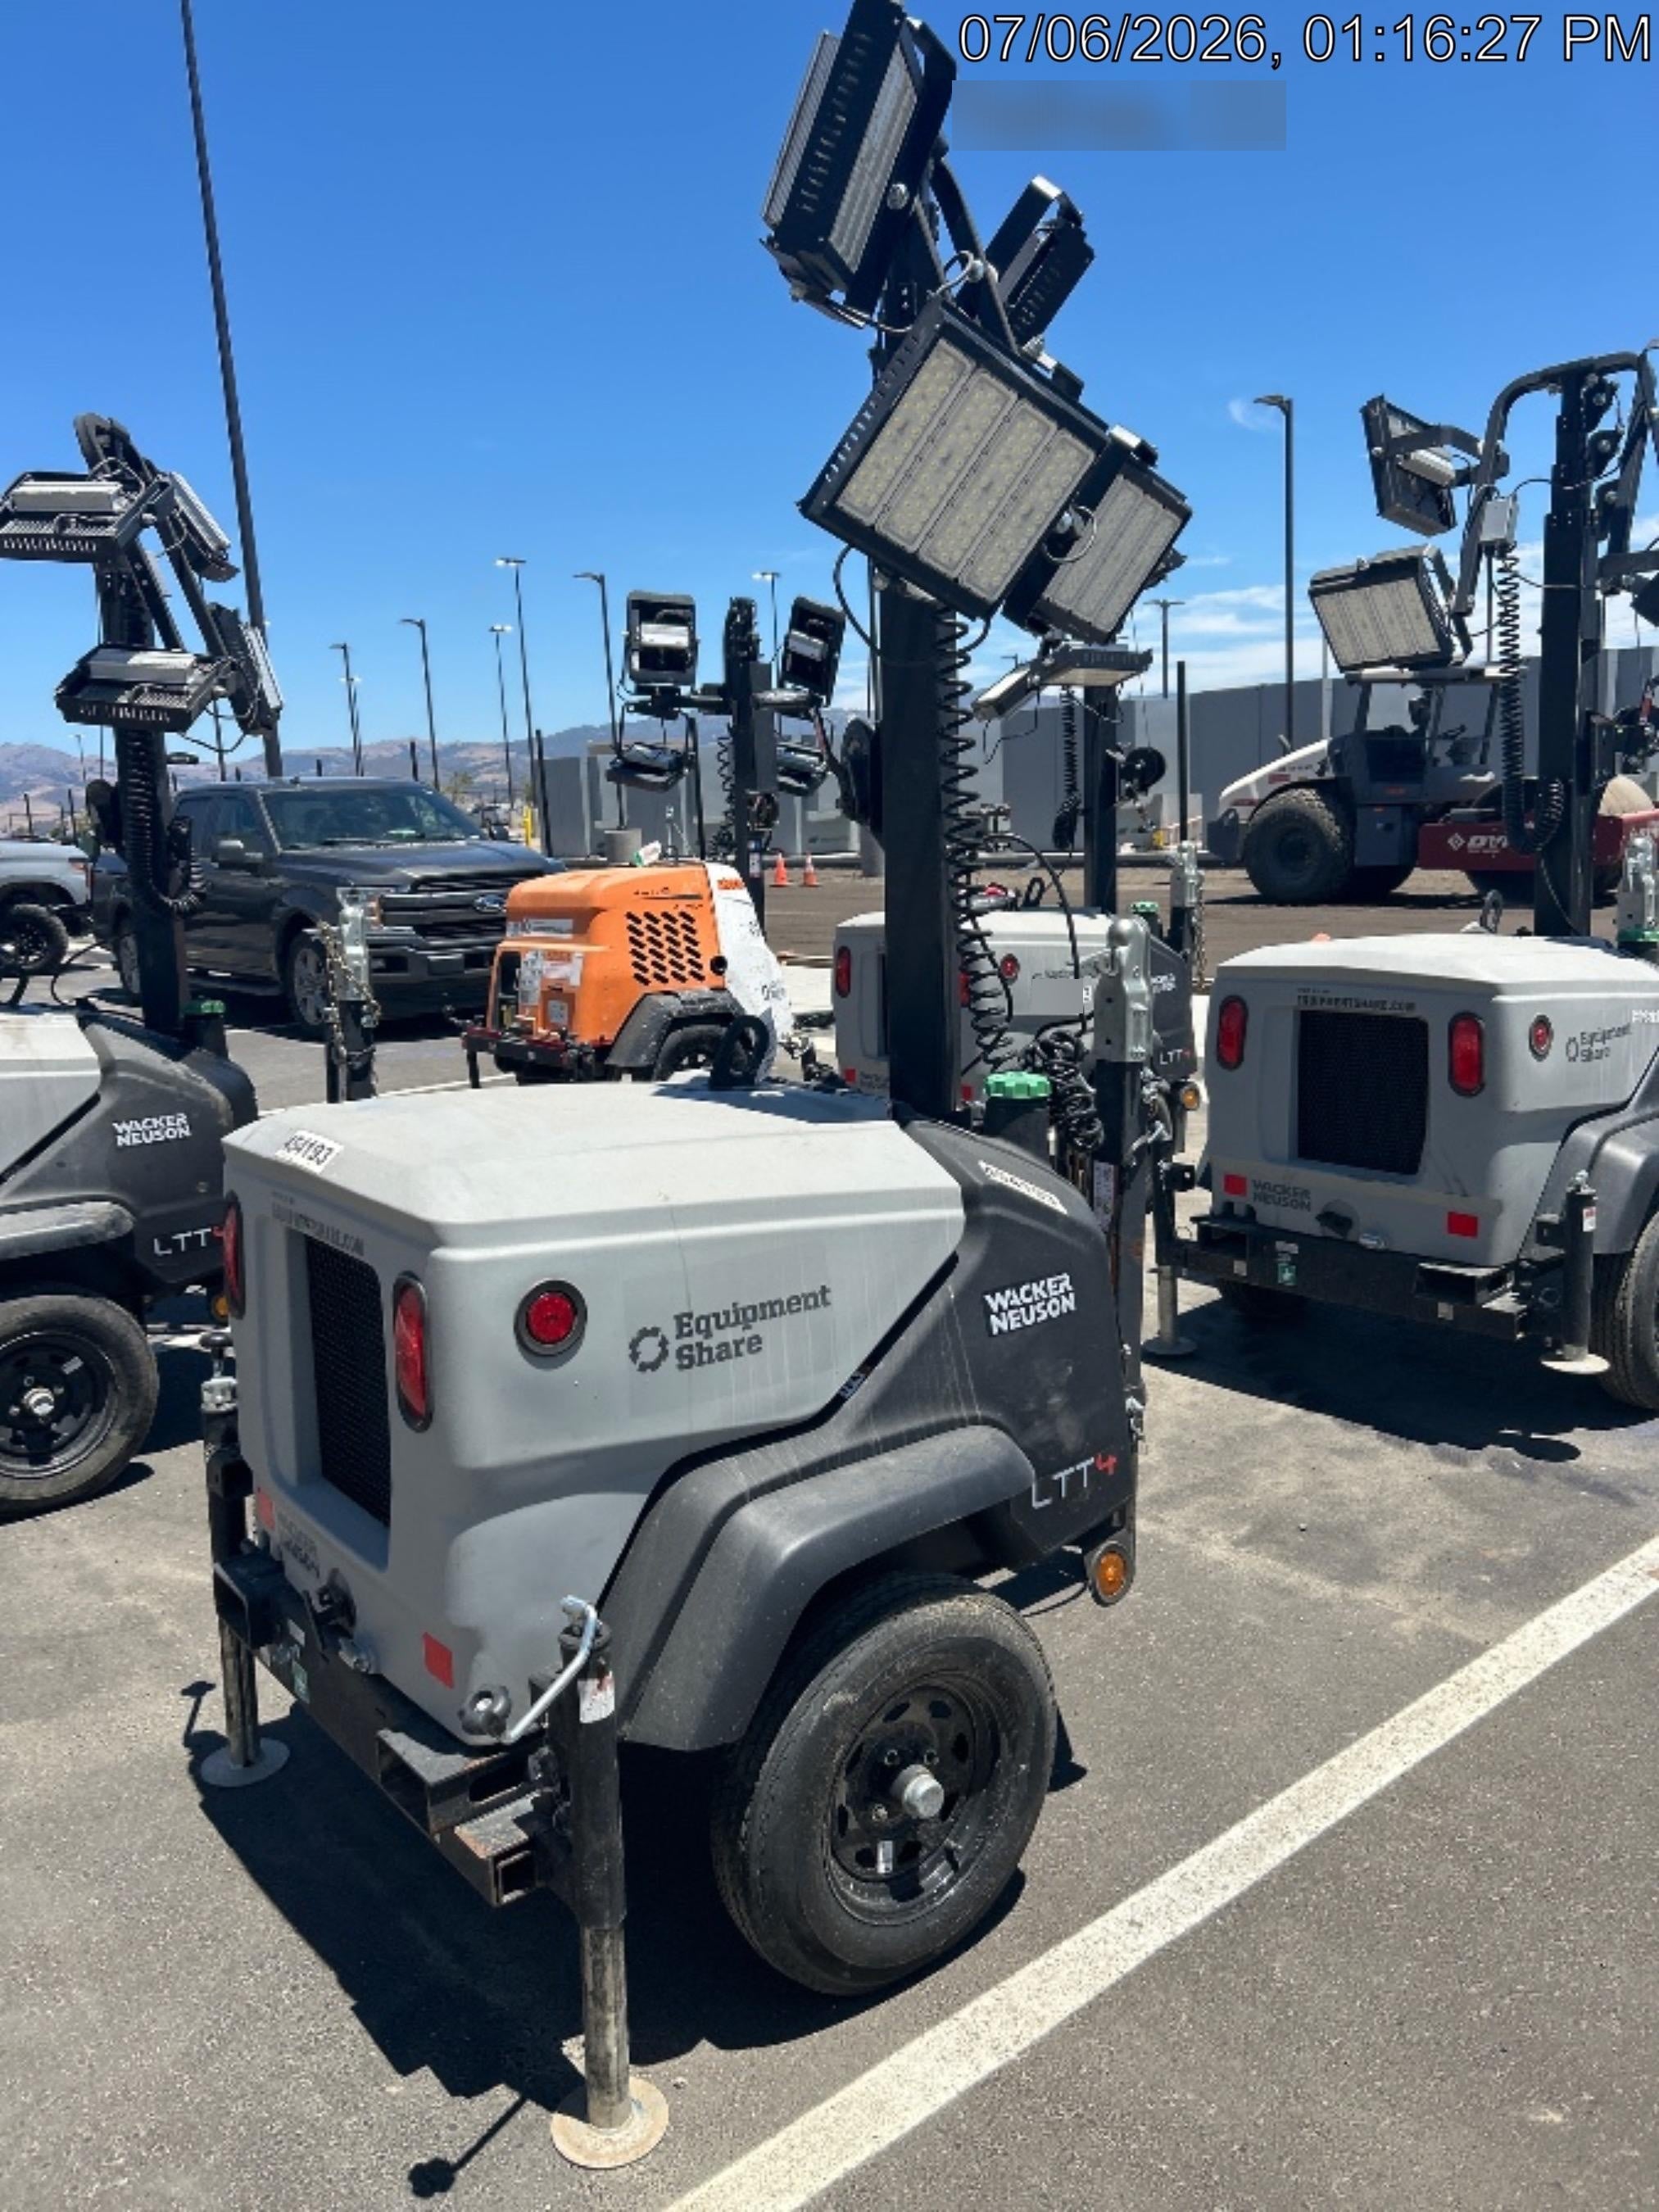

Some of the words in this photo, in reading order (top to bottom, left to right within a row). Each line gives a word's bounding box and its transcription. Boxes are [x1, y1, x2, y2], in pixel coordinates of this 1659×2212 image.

[112, 1113, 188, 1133] WACKER
[116, 1125, 192, 1146] NEUSON
[673, 1285, 832, 1339] Equipment
[984, 1272, 1073, 1312] WACKER
[990, 1292, 1077, 1335] NEUSON
[675, 1334, 763, 1371] Share
[1031, 1453, 1117, 1509] LTT4
